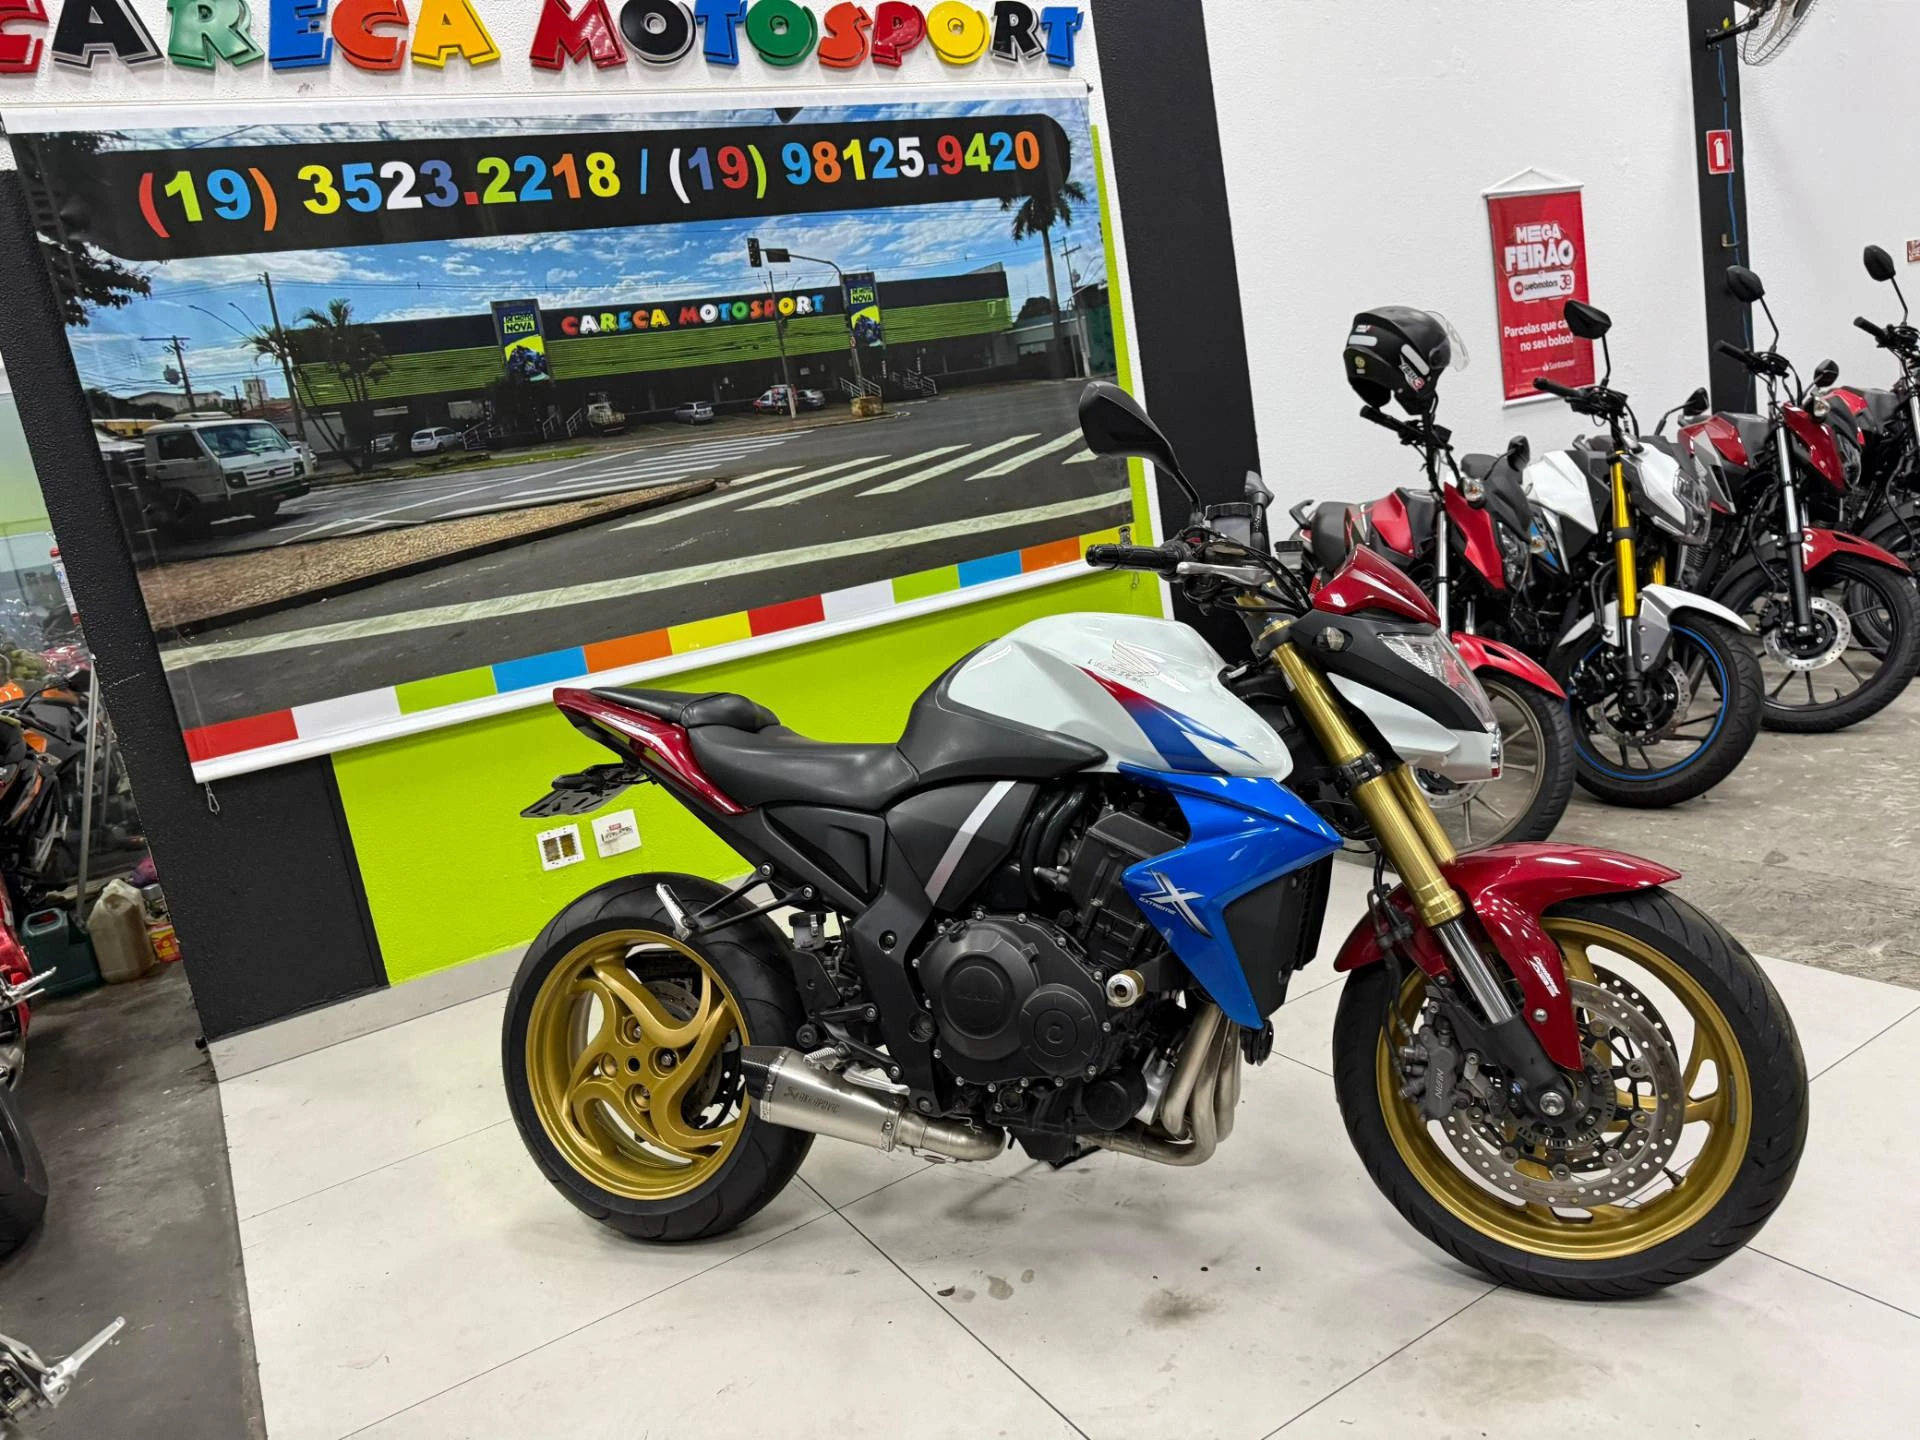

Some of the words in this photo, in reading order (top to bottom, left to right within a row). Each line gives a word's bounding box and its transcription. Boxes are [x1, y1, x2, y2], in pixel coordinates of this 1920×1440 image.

[529, 0, 1084, 71] MOTOSPORT
[138, 167, 278, 239] (19)
[297, 151, 621, 215] 3523.2218
[669, 144, 767, 204] (19)
[781, 130, 1040, 186] 98125.9420
[1515, 223, 1561, 244] MEGA
[1504, 238, 1575, 272] FEIRÃO
[852, 293, 873, 304] NOVA
[561, 308, 671, 336] CARECA
[679, 294, 825, 326] MOTOSPORT
[505, 322, 534, 333] NOVA
[1503, 323, 1541, 338] Parcelas
[1541, 320, 1558, 335] que
[1520, 341, 1532, 352] no
[1533, 338, 1548, 350] seu
[1548, 331, 1574, 347] bolso!
